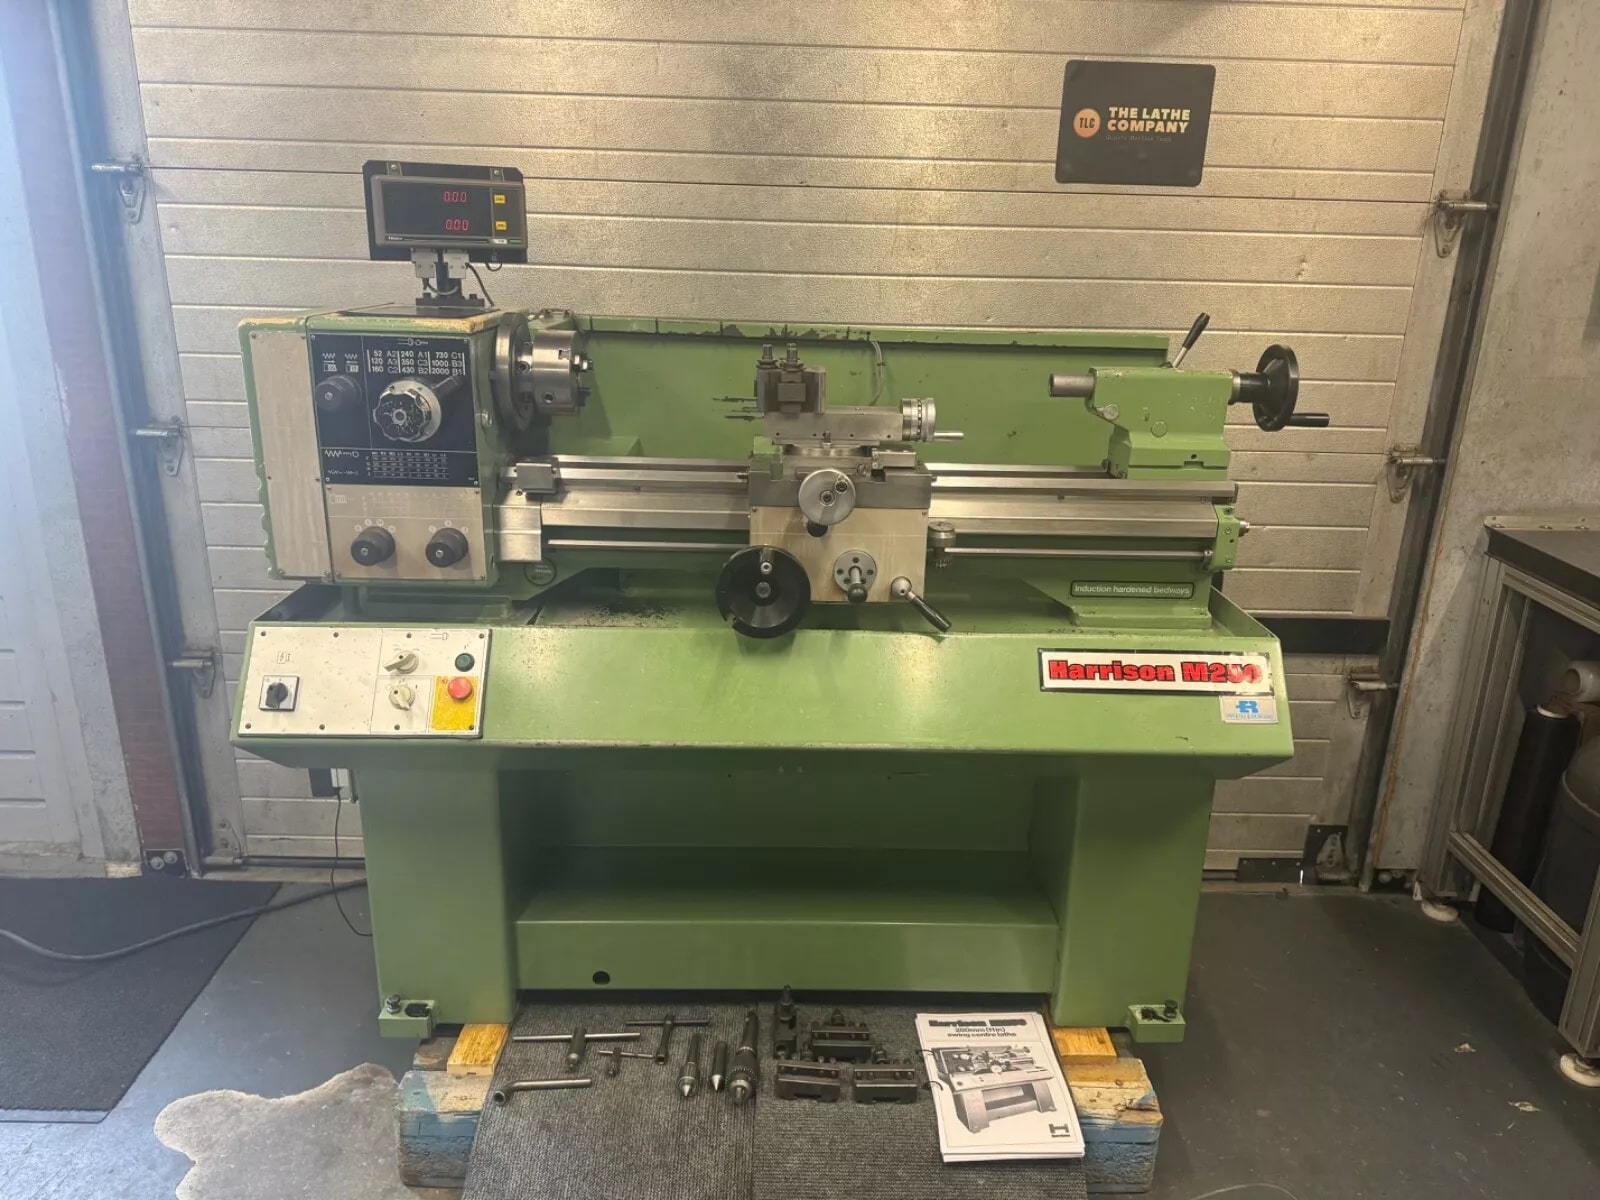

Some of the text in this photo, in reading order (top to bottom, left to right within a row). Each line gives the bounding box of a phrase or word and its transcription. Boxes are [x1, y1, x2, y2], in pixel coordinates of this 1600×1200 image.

[1108, 106, 1191, 121] THE LATHE
[1078, 117, 1096, 129] TLC
[1107, 119, 1190, 134] COMPANY
[435, 351, 449, 359] 730
[401, 366, 415, 374] 430
[1113, 585, 1153, 593] hardened
[1153, 585, 1190, 595] bedways
[1048, 660, 1263, 684] Harrison M250
